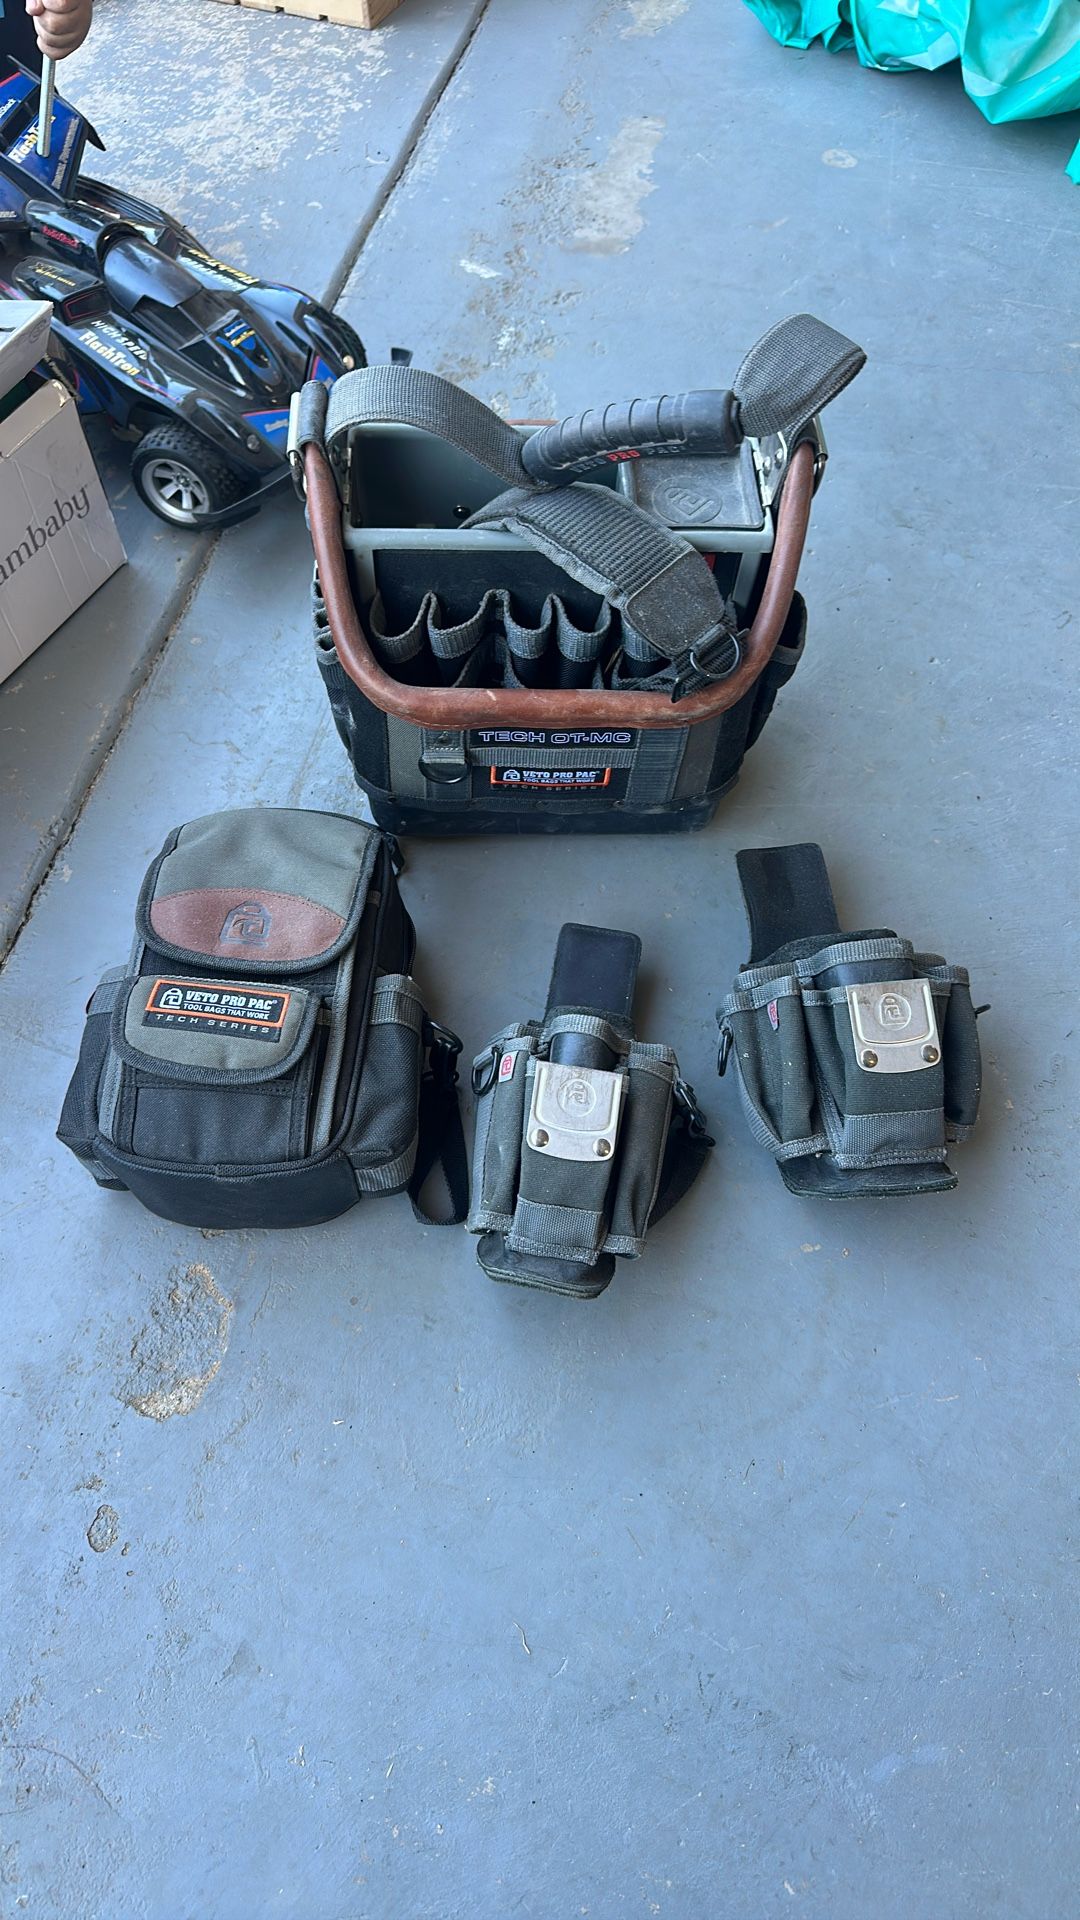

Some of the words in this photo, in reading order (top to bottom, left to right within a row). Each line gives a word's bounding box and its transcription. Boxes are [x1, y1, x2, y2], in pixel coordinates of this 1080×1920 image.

[91, 320, 121, 340] HIGH
[119, 336, 148, 360] SPEED
[607, 449, 641, 462] PRO
[478, 731, 546, 743] TECH
[522, 770, 550, 778] VETO
[184, 990, 219, 1004] VETO
[220, 995, 246, 1007] PRO
[183, 1003, 203, 1011] TOOL
[204, 1006, 226, 1015] BAGS
[227, 1008, 247, 1017] THAT
[246, 1011, 270, 1020] WORK
[156, 1013, 198, 1024] TECH
[207, 1019, 271, 1034] SERIES
